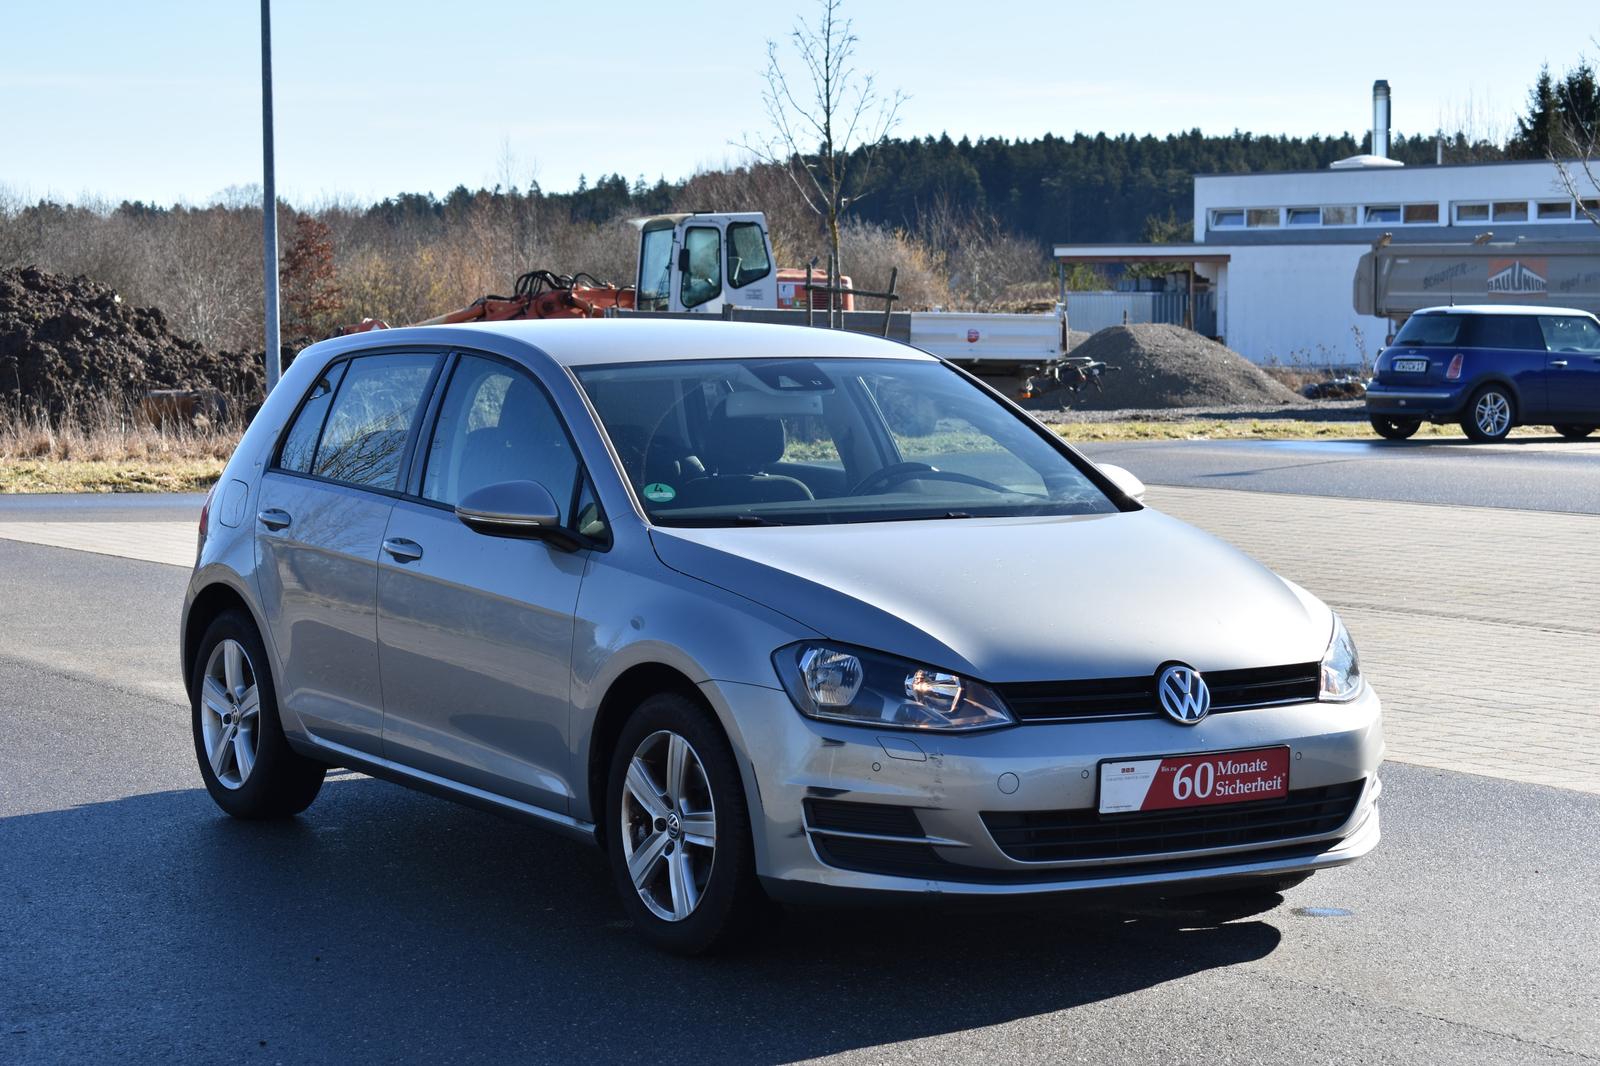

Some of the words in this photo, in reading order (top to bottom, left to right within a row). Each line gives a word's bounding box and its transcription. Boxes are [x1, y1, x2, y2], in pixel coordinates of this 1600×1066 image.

[654, 484, 664, 493] 4
[1161, 668, 1209, 722] VW
[1172, 762, 1215, 800] 60
[1217, 759, 1268, 776] Monate
